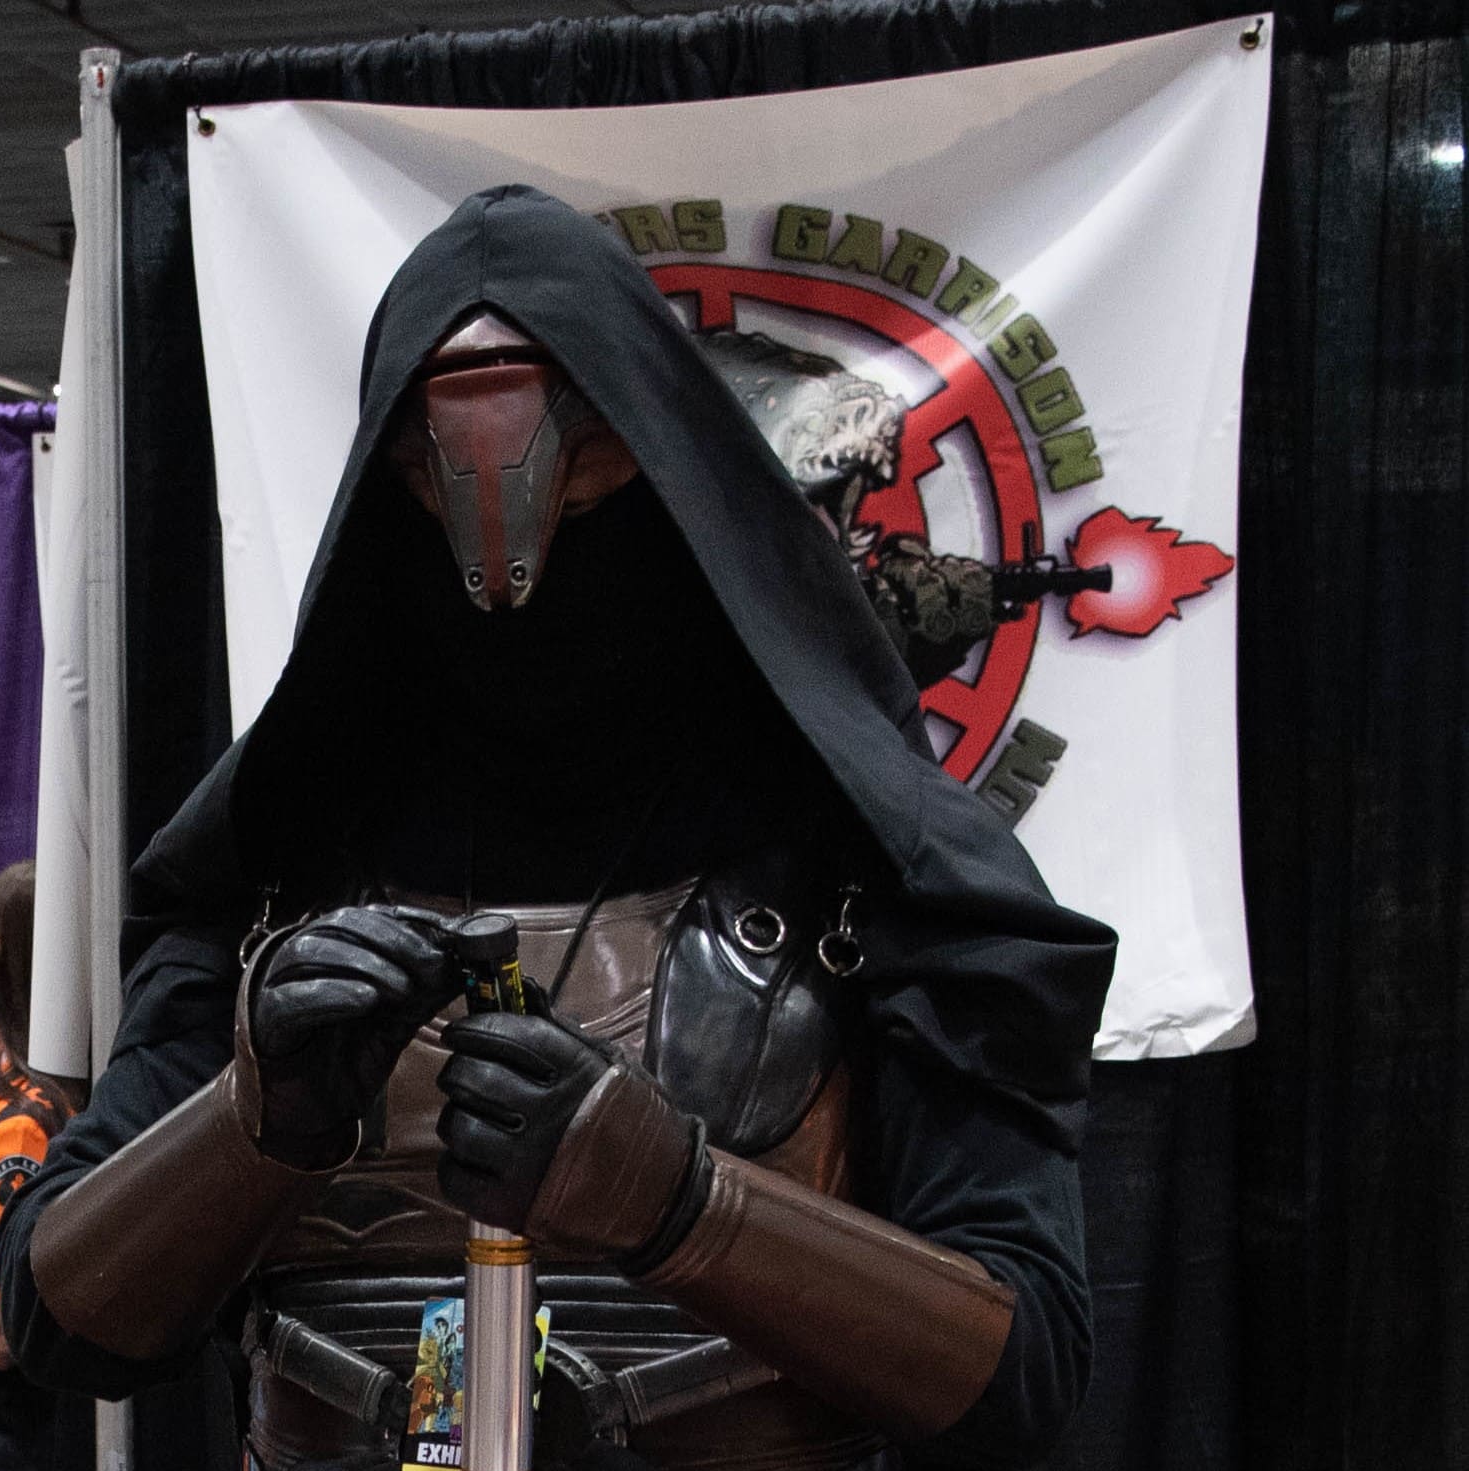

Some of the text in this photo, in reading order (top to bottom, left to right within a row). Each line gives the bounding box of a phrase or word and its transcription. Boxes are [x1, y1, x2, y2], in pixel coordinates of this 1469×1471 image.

[600, 200, 1105, 494] RS GARRISON
[974, 717, 1068, 830] ON
[416, 1442, 462, 1466] EXHI
